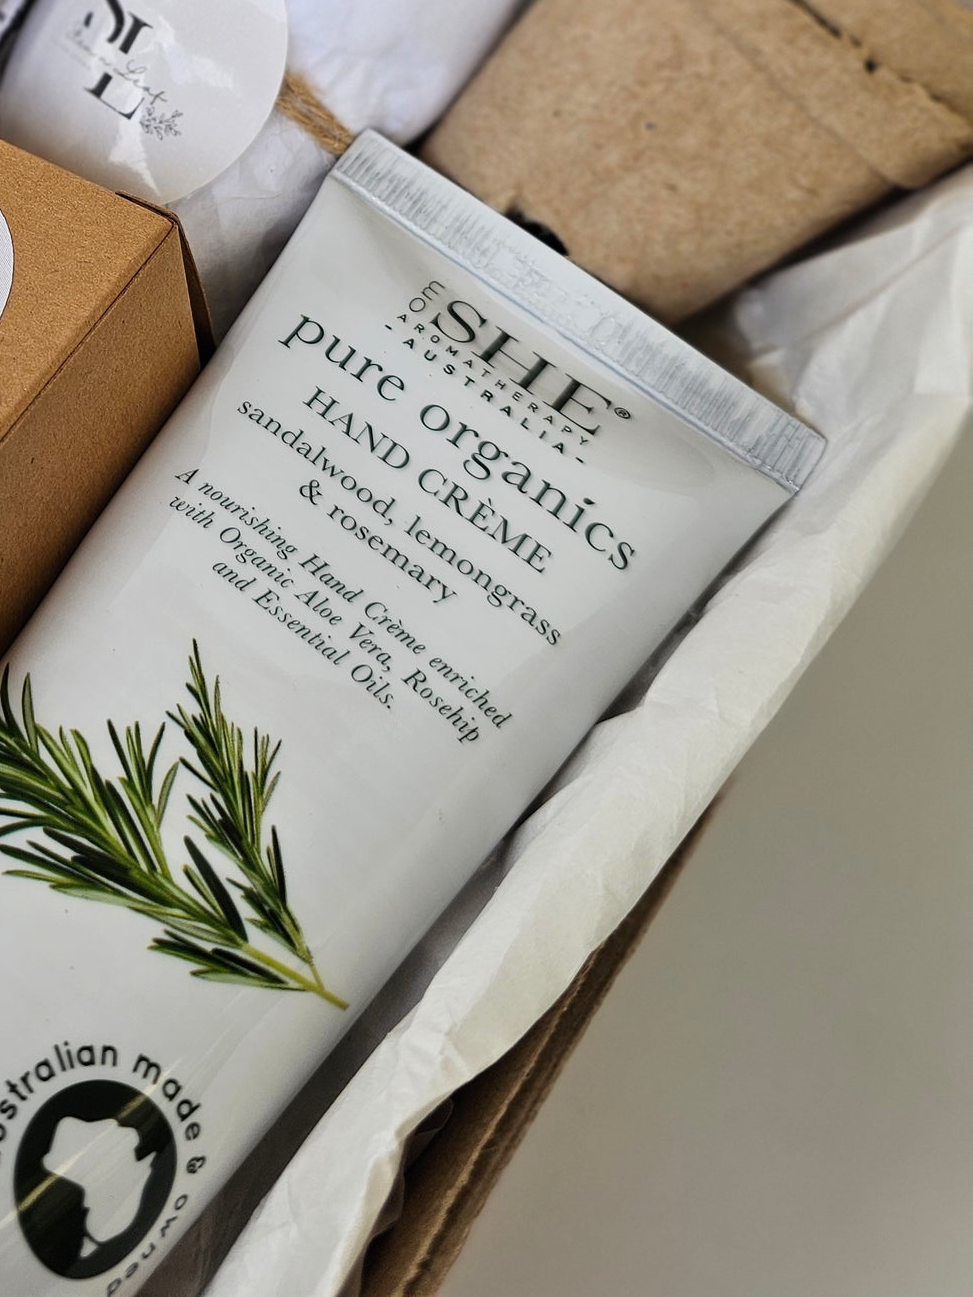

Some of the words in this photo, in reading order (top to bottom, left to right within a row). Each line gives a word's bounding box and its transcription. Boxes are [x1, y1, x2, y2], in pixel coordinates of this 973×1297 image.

[278, 314, 405, 402] pure
[419, 403, 636, 571] organics
[397, 313, 589, 446] AROMATHERAPY
[402, 337, 565, 455] AUSTRALIA
[237, 401, 396, 526] sandalwood,
[404, 514, 561, 646] lemongrass
[299, 479, 323, 506] &
[327, 504, 458, 604] rosemary
[302, 386, 410, 470] HAND
[418, 468, 552, 574] CRÈME
[169, 496, 216, 530] with
[219, 526, 295, 589] Organic
[293, 589, 344, 626] Aloe
[348, 622, 392, 673] Vera,
[400, 668, 480, 746] Rosehip
[174, 468, 200, 485] A
[198, 482, 298, 561] nourishing
[298, 553, 365, 603] Hand
[364, 601, 427, 655] Crème
[429, 656, 513, 730] enriched
[212, 561, 257, 593] and
[252, 588, 351, 666] Essential
[350, 664, 395, 710] Oils.
[132, 1053, 202, 1142] made
